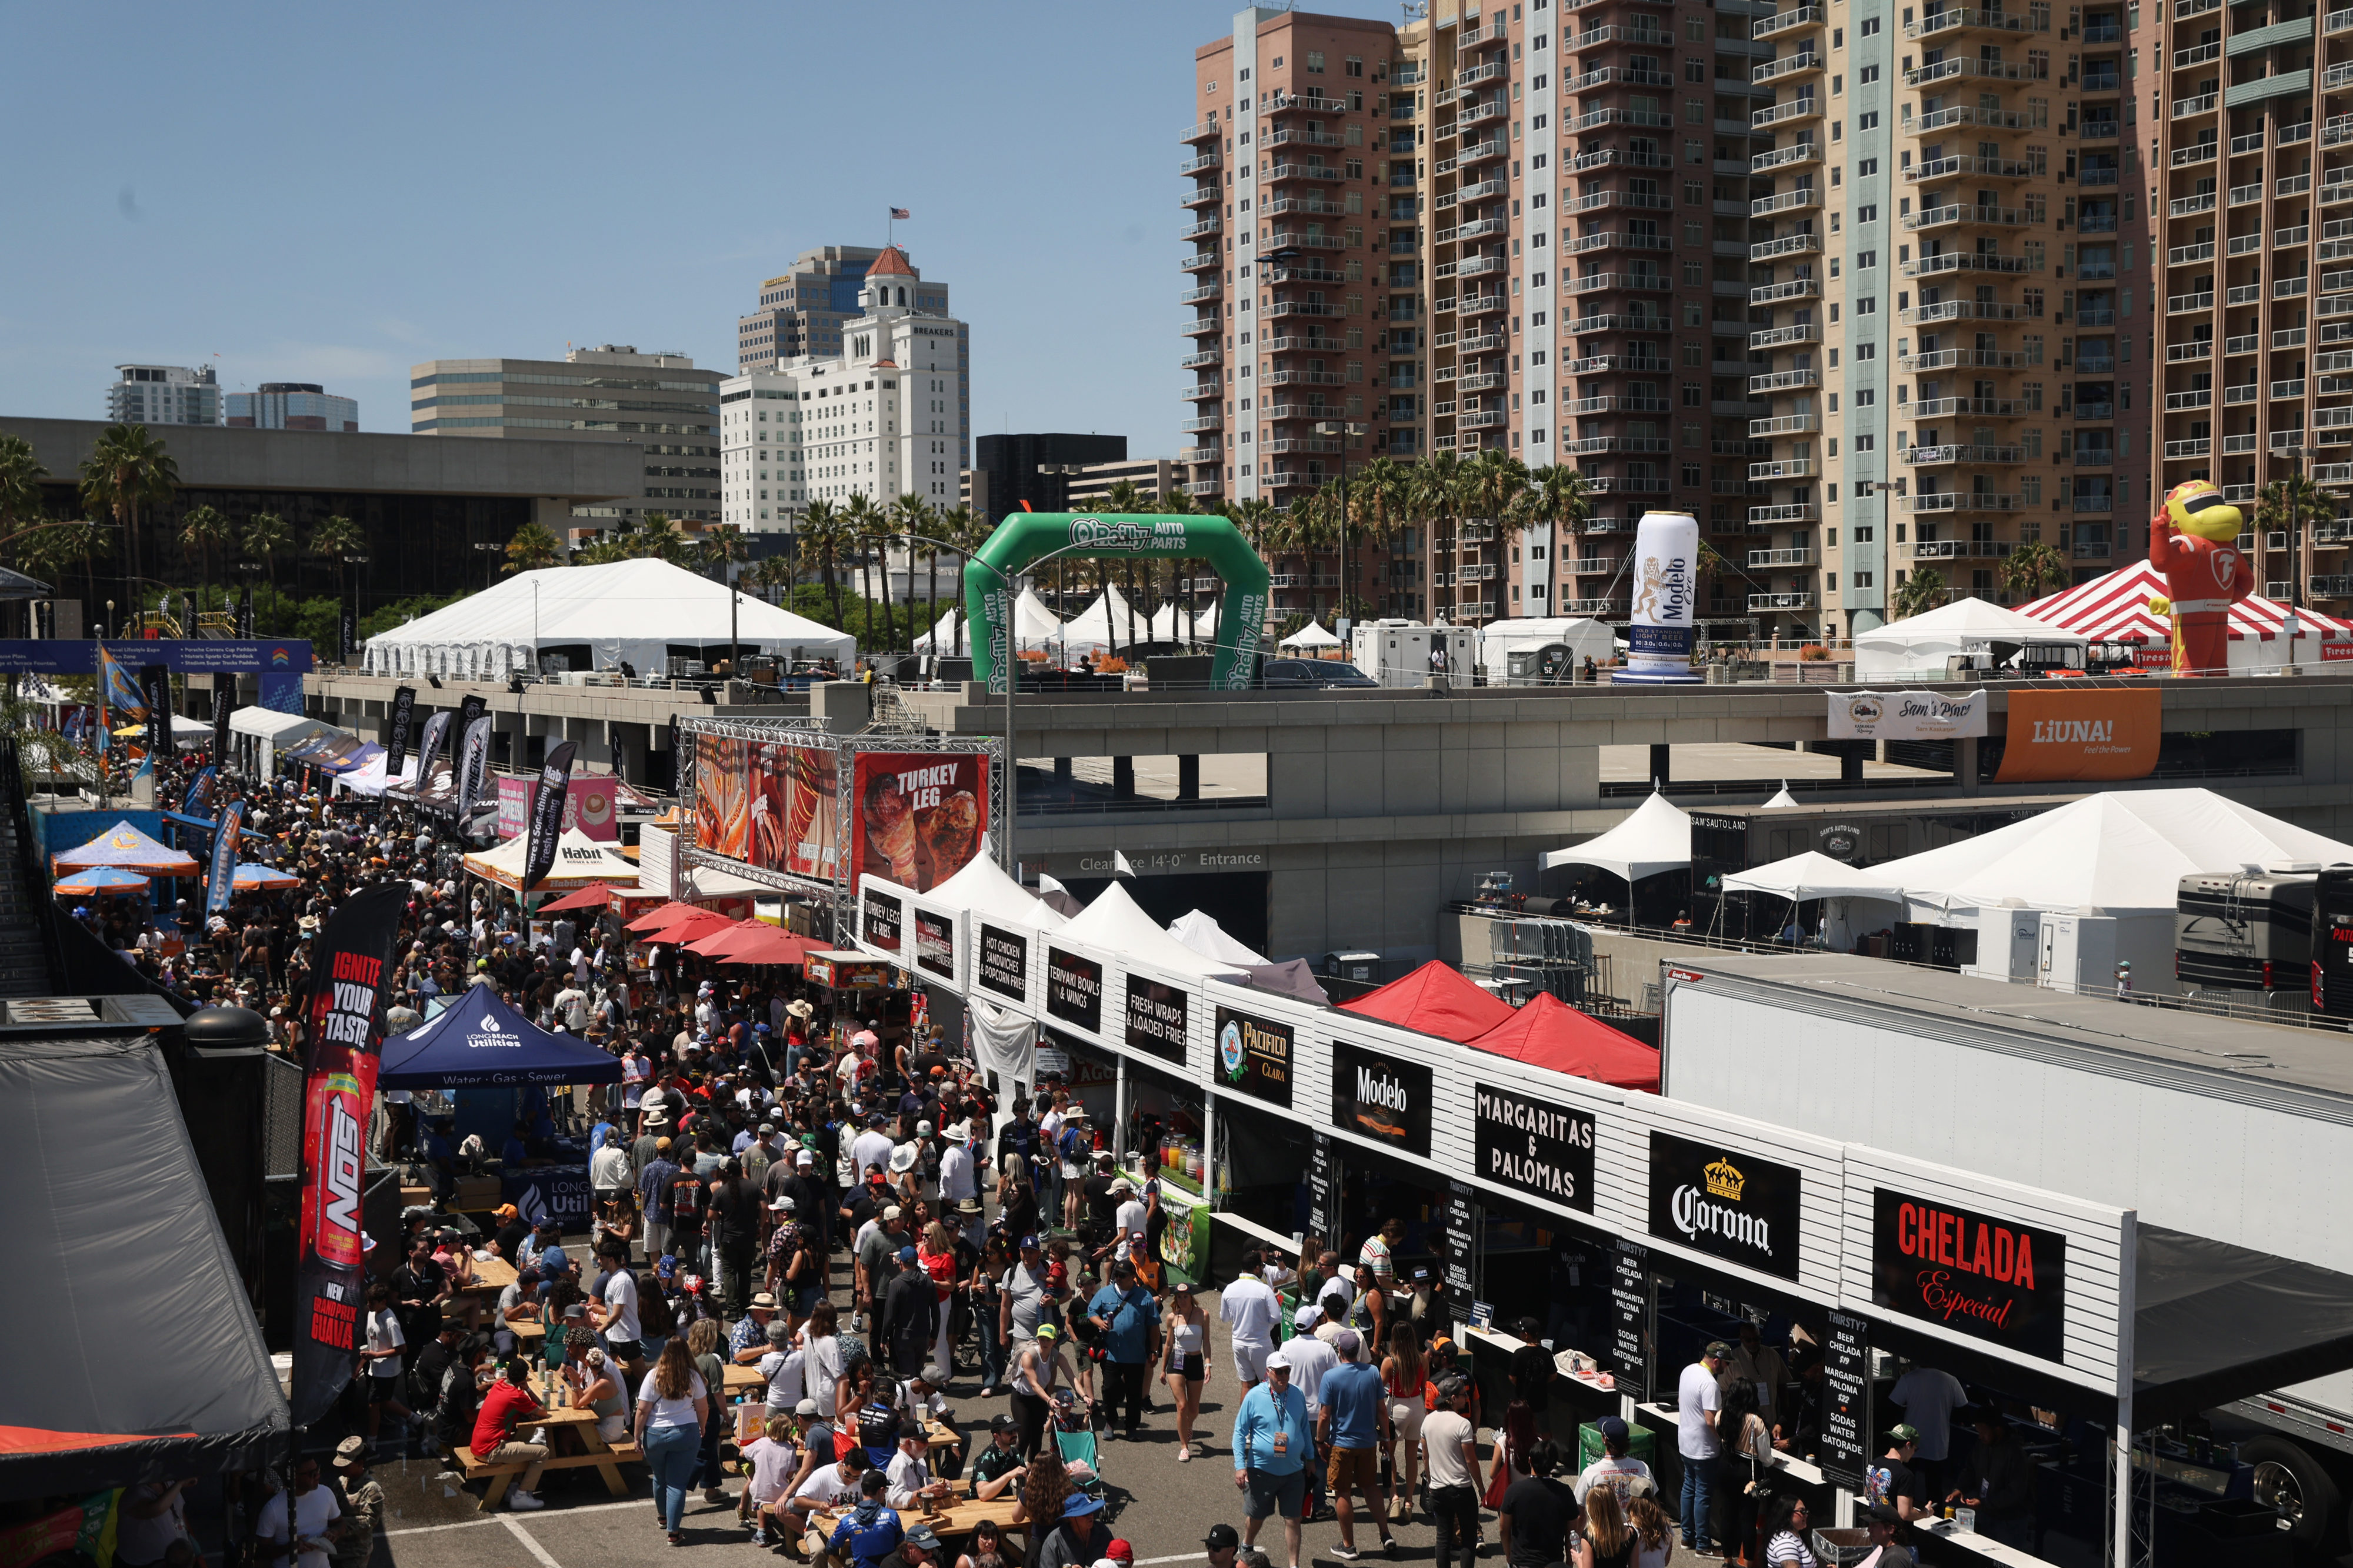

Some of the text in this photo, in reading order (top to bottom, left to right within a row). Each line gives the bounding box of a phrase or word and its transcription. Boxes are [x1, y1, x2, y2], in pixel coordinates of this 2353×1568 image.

[914, 327, 954, 336] BREAKERS
[1155, 522, 1184, 534] AUTO
[1151, 538, 1186, 549] PARTS
[1663, 558, 1685, 620] Modelo
[1684, 576, 1692, 605] Oro
[986, 594, 996, 622] AUTO
[1239, 595, 1254, 622] AUTO
[1251, 595, 1264, 628] PARTS
[1899, 700, 1937, 717] Sam's
[2032, 720, 2112, 742] LiUNA!
[544, 765, 569, 785] Habit
[898, 763, 958, 795] TURKEY
[913, 787, 940, 811] LEG
[533, 786, 550, 837] Something
[545, 799, 560, 837] Cooking
[1820, 826, 1834, 836] SAM'S
[1848, 826, 1860, 835] LAND
[528, 838, 539, 873] There's
[540, 839, 551, 864] Fresh
[562, 848, 602, 859] Habit
[214, 843, 229, 900] LOTTERY
[1022, 853, 1261, 873] Exit Clearce Entrance
[865, 899, 900, 926] TURKEY LEGS
[873, 922, 891, 939] & RIBS
[925, 922, 942, 936] LOADED
[918, 932, 951, 954] GRILLED CHEESE
[986, 936, 1020, 959] HOT CHICKEN
[921, 948, 952, 969] SAUCY TENDERS
[986, 951, 1019, 973] SANDWICHES
[332, 952, 382, 987] IGNITE
[980, 963, 1025, 991] & POPCORN FRIES
[1049, 965, 1100, 996] TERIYAKI BOWLS
[334, 982, 374, 1017] YOUR
[1060, 986, 1087, 1009] & WINGS
[1131, 994, 1181, 1025] FRESH WRAPS
[1126, 1011, 1185, 1046] & LOADED FRIES
[1257, 1023, 1287, 1036] CERVEZA
[468, 1039, 521, 1048] Utilities
[1244, 1021, 1287, 1057] PACIFICO
[1262, 1062, 1285, 1082] CLARA
[1372, 1062, 1391, 1074] CERVEZA
[443, 1072, 566, 1085] Water Gas Sewer
[1357, 1066, 1407, 1112] Modelo
[1478, 1092, 1592, 1149] MARGARITAS
[1529, 1135, 1537, 1157] &
[326, 1093, 359, 1234] NOS
[1312, 1156, 1327, 1167] CHELADA
[1492, 1147, 1575, 1197] PALOMAS
[1311, 1175, 1328, 1187] MARGARITA
[1313, 1184, 1325, 1195] PALOMA
[1449, 1180, 1473, 1196] THIRSTY?
[1312, 1207, 1324, 1217] SODAS
[1454, 1199, 1465, 1209] BEER
[1312, 1213, 1324, 1224] WATER
[1449, 1207, 1469, 1219] CHELADA
[1672, 1185, 1769, 1252] Corona
[1309, 1219, 1327, 1233] GATORADE
[1447, 1227, 1471, 1242] MARGARITA
[1449, 1237, 1468, 1250] PALOMA
[1616, 1239, 1647, 1257] THIRSTY?
[1898, 1202, 2034, 1290] CHELADA
[1449, 1263, 1467, 1275] SODAS
[1623, 1257, 1637, 1268] BEER
[1449, 1271, 1466, 1282] WATER
[1617, 1266, 1642, 1280] CHELADA
[1445, 1276, 1472, 1291] GATORADE
[1624, 1278, 1632, 1287] $19
[326, 1282, 344, 1302] NEW
[1612, 1288, 1644, 1305] MARGARITA
[1917, 1270, 2012, 1330] Especial
[314, 1296, 357, 1323] GRAND PRIX
[1617, 1299, 1639, 1313] PALOMA
[1624, 1313, 1633, 1321] $22
[1828, 1310, 1867, 1332] THIRSTY?
[311, 1312, 353, 1350] GUAVA
[1618, 1329, 1638, 1343] SODAS
[1837, 1331, 1854, 1344] BEER
[1618, 1339, 1637, 1353] WATER
[1829, 1340, 1861, 1357] CHELADA
[1613, 1349, 1643, 1366] GATORADE
[1839, 1355, 1849, 1365] $19
[1624, 1363, 1631, 1371] $8
[1824, 1365, 1864, 1386] MARGARITA
[1829, 1379, 1858, 1396] PALOMA
[1838, 1393, 1849, 1404] $22
[1830, 1412, 1856, 1428] SODAS
[1829, 1424, 1855, 1440] WATER
[1822, 1434, 1862, 1454] GATORADE
[1838, 1450, 1846, 1460] $8
